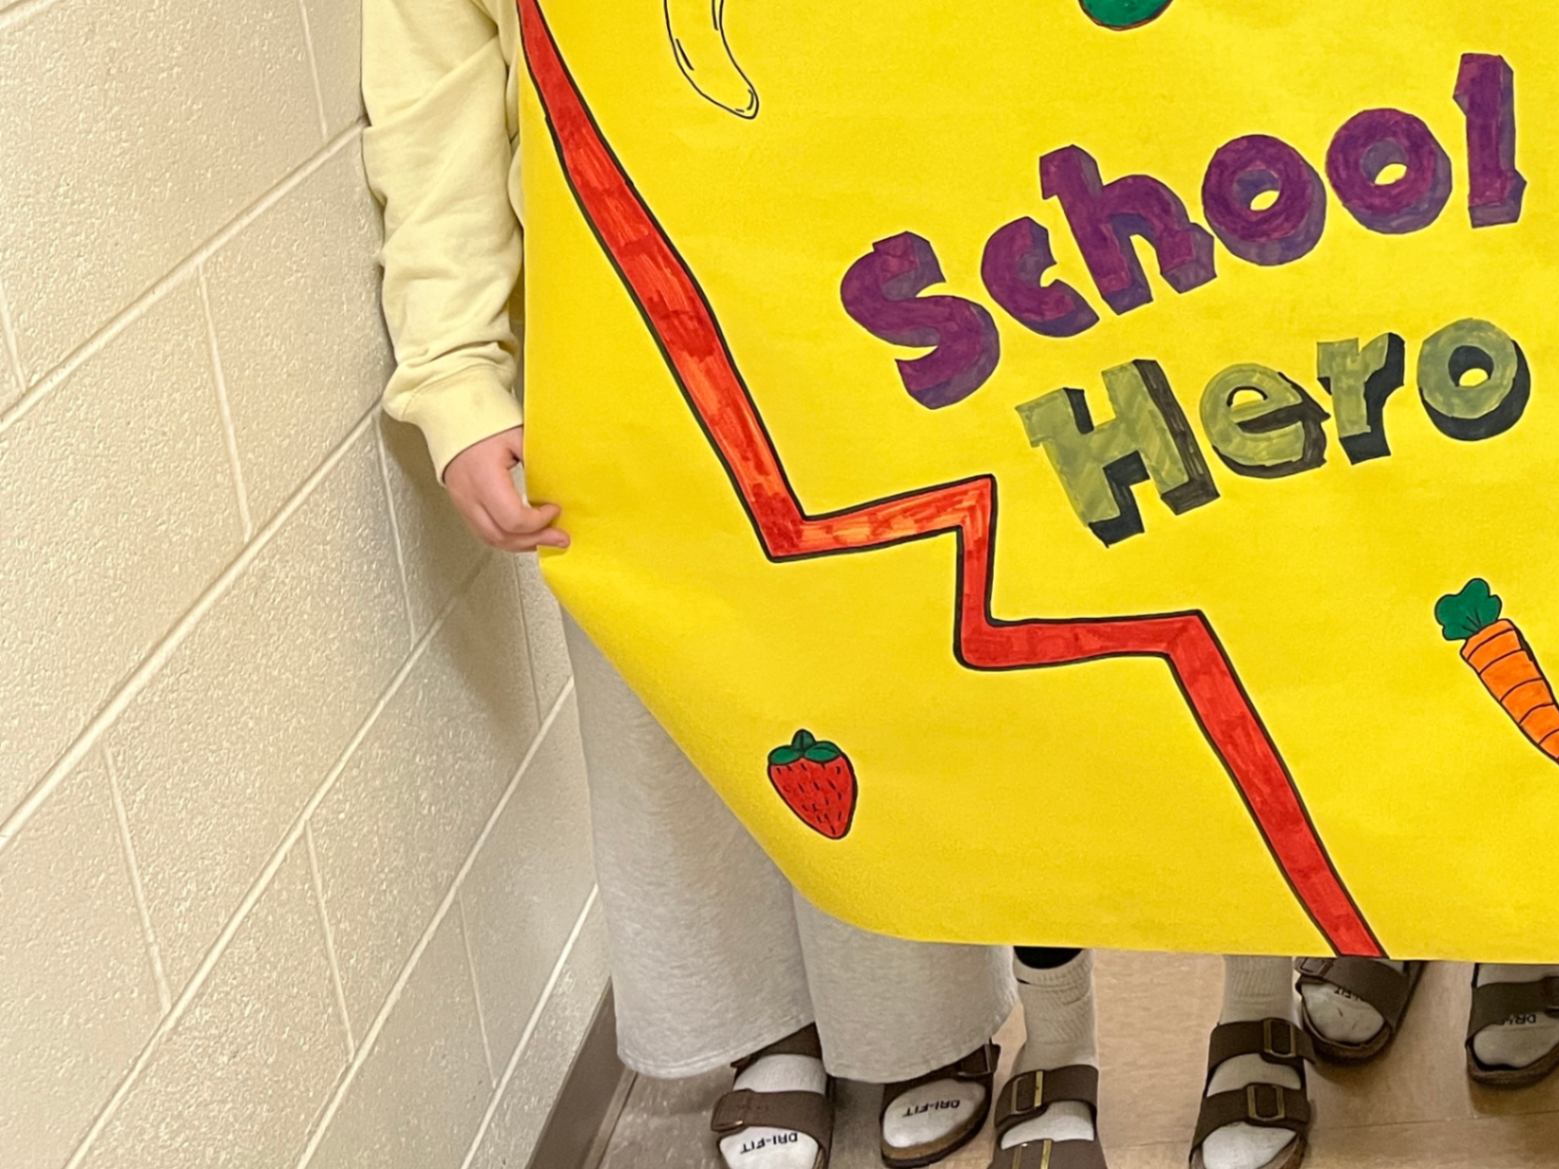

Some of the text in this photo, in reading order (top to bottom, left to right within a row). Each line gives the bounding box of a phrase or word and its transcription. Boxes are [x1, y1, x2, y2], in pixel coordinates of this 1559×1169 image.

[840, 53, 1528, 410] School
[1015, 318, 1531, 548] Hero
[740, 1131, 799, 1155] DRI-FIT
[902, 1098, 961, 1118] DRI-FIT
